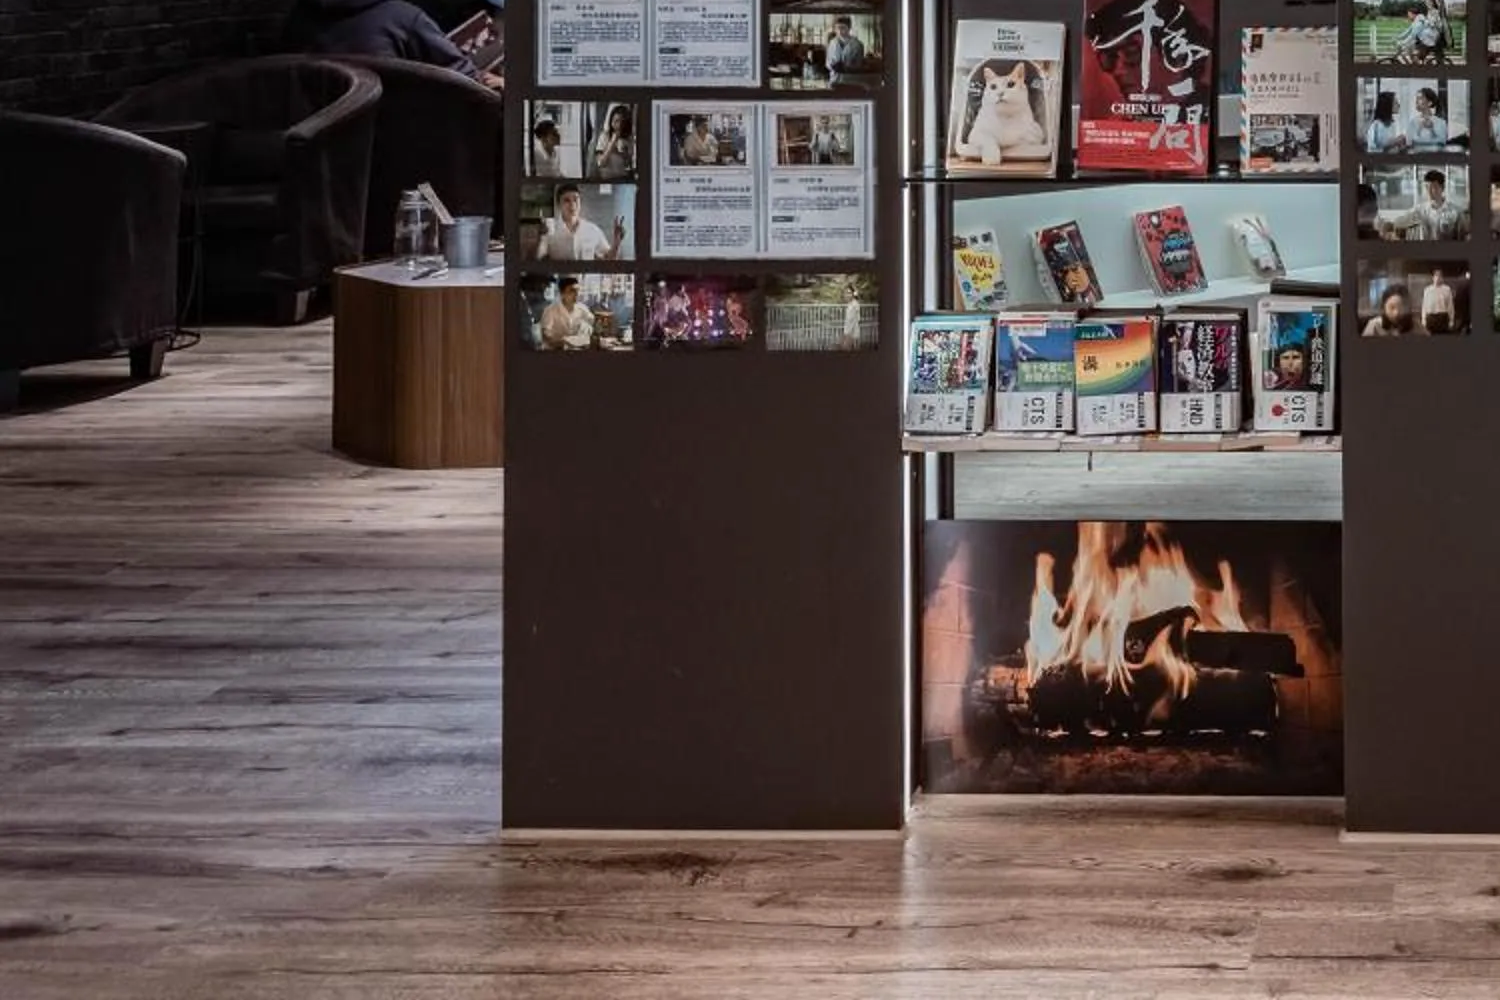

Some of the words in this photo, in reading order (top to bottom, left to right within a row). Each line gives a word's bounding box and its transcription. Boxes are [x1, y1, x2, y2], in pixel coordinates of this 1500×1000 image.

[1111, 102, 1149, 115] CHEN
[1030, 397, 1046, 425] CTS
[1189, 397, 1204, 426] HND
[1291, 395, 1305, 424] CTS
